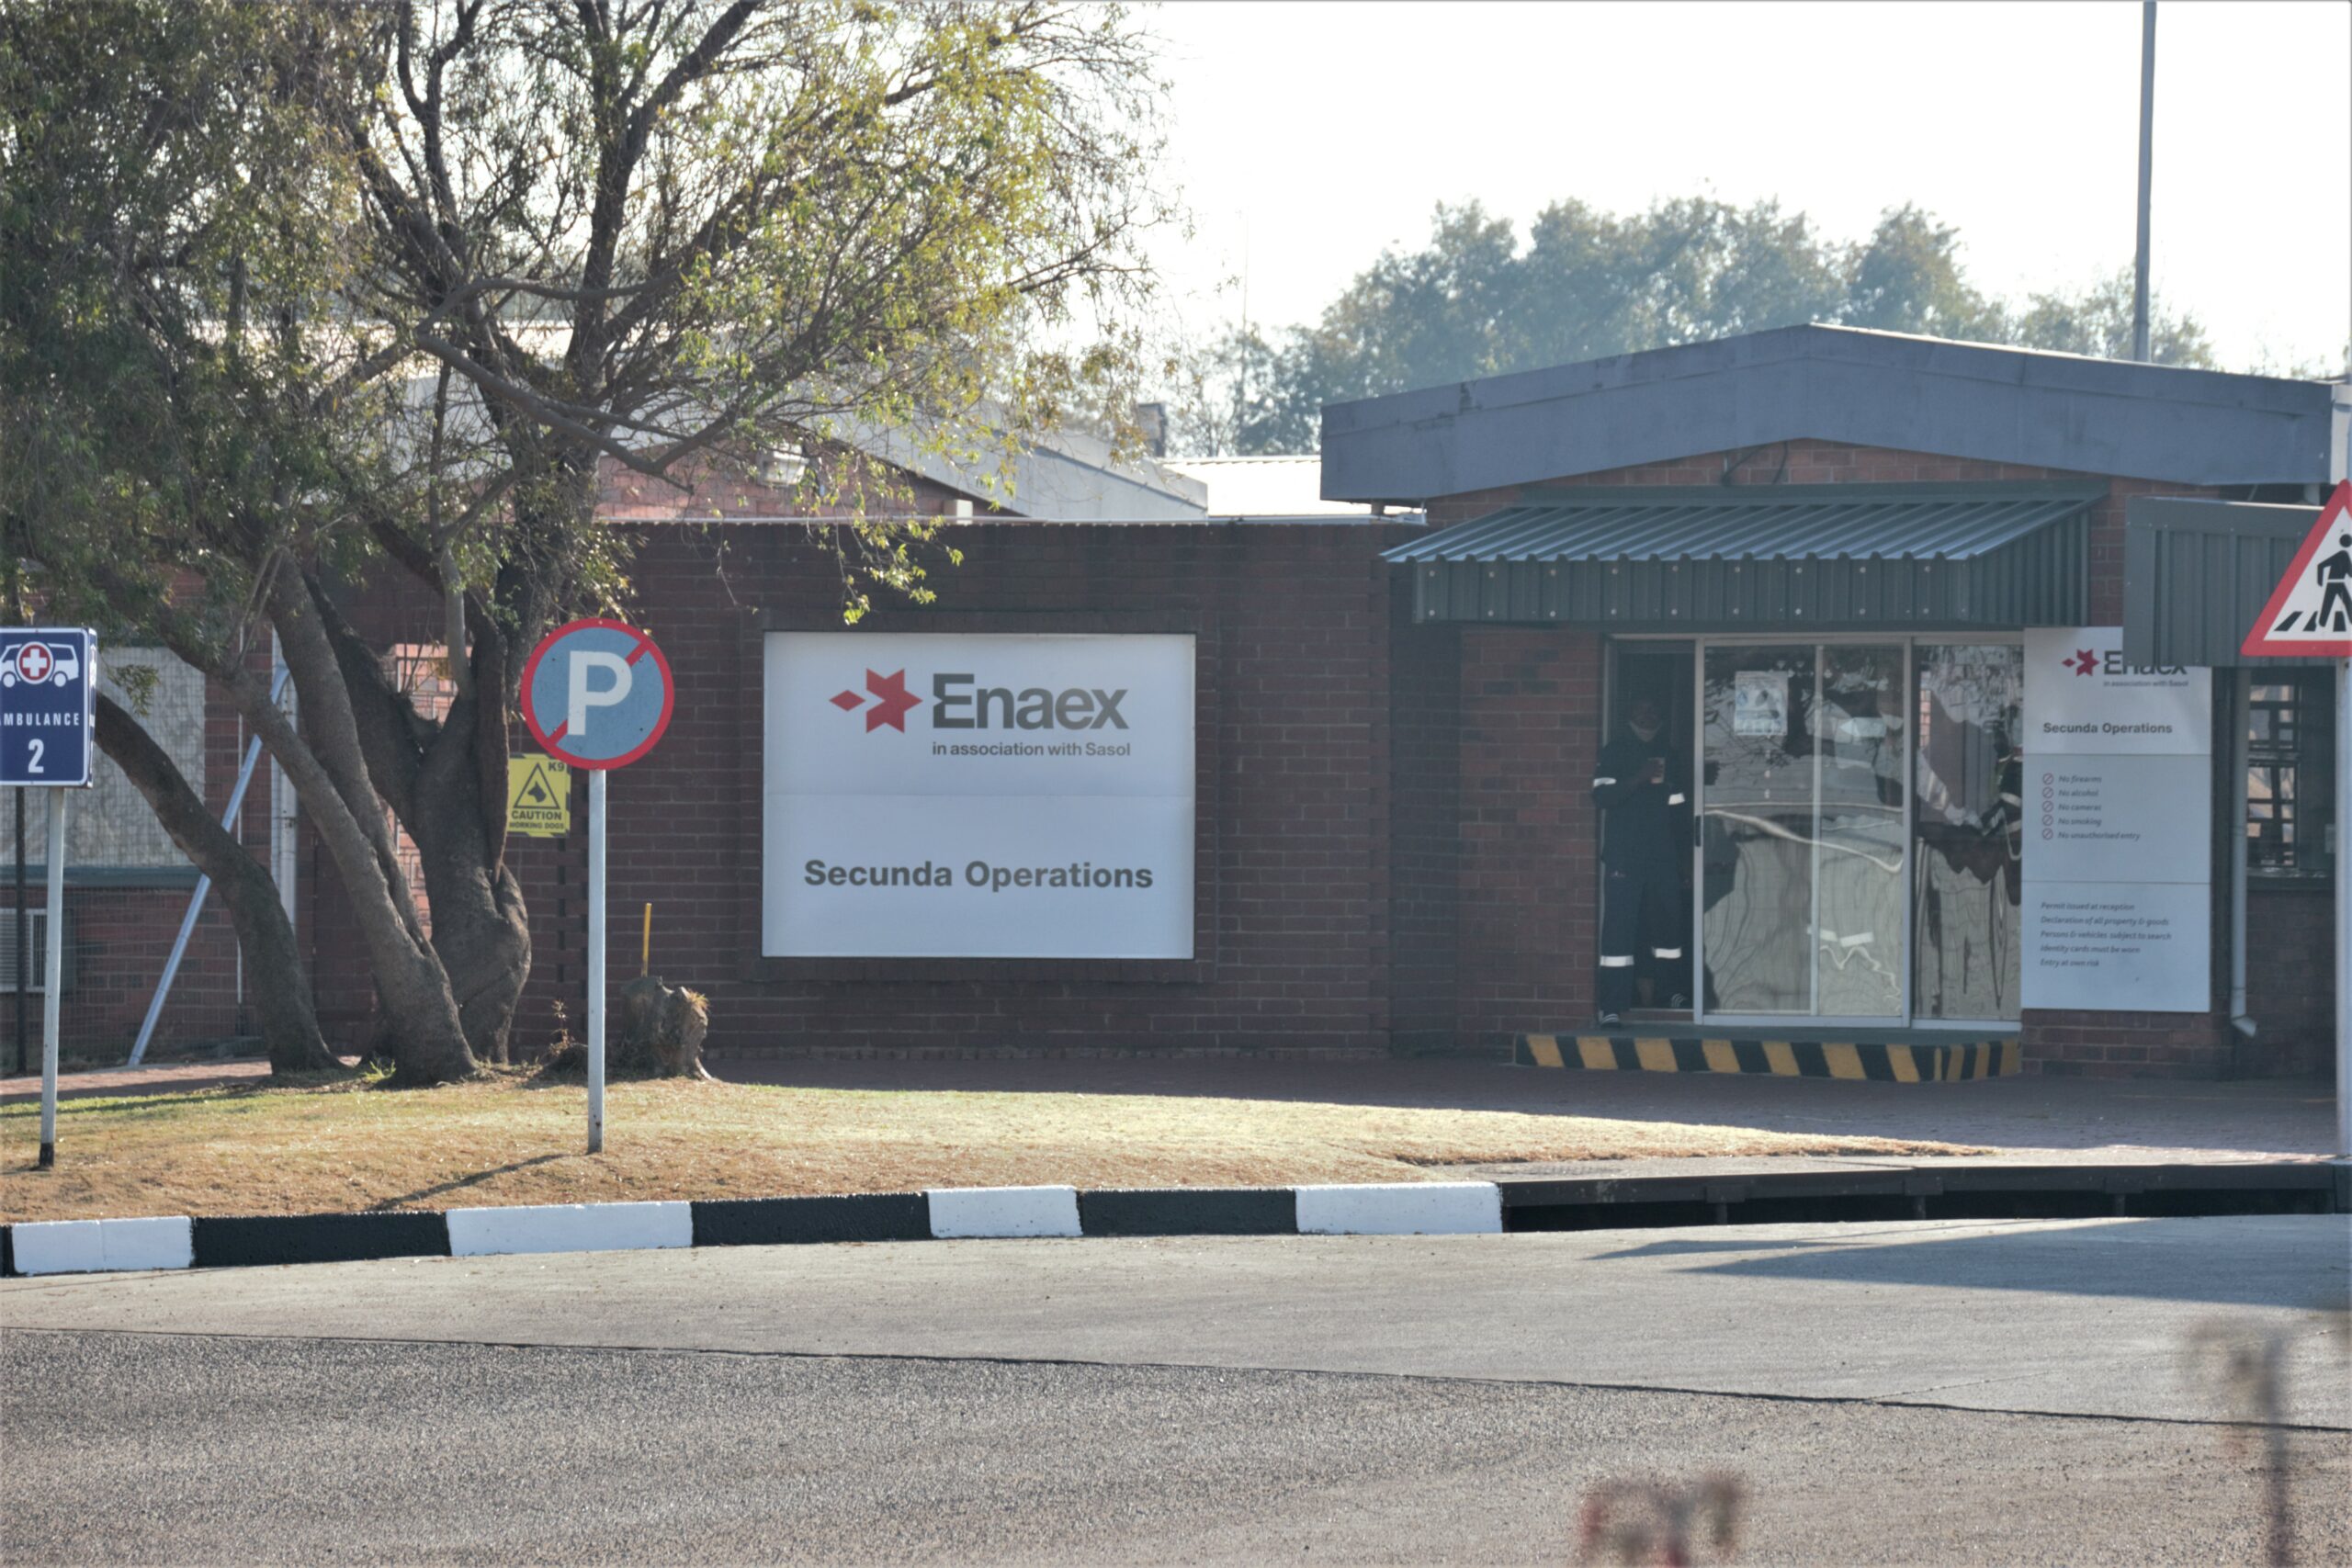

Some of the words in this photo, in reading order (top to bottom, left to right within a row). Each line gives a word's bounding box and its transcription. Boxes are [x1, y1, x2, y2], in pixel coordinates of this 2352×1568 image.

[568, 650, 633, 735] P
[933, 673, 1130, 730] Enaex
[0, 713, 80, 726] MBULANCE
[2043, 722, 2098, 734] Secunda
[2102, 722, 2173, 736] Operations
[932, 742, 947, 756] in
[950, 742, 1044, 756] association
[1047, 742, 1082, 756] with
[1085, 742, 1130, 757] Sasol
[28, 739, 44, 773] 2
[548, 761, 565, 773] K9
[2058, 774, 2070, 784] No
[2058, 789, 2070, 797] No
[2071, 788, 2099, 797] alcohol
[2058, 803, 2070, 811] No
[511, 810, 562, 821] CAUTION
[2058, 817, 2070, 825] No
[2071, 817, 2102, 828] smoking
[2120, 832, 2141, 842] entry
[804, 859, 953, 886] Secunda
[965, 861, 1154, 892] Operations
[2041, 902, 2066, 910] Permit
[2099, 903, 2135, 912] reception
[2085, 916, 2094, 926] of
[2094, 916, 2103, 924] all
[2103, 917, 2137, 927] property
[2146, 918, 2169, 927] goods
[2078, 931, 2108, 939] vehicles
[2109, 931, 2137, 942] subject
[2138, 931, 2147, 940] to
[2041, 944, 2069, 954] Identity
[2110, 945, 2120, 953] be
[2041, 958, 2060, 968] Entry
